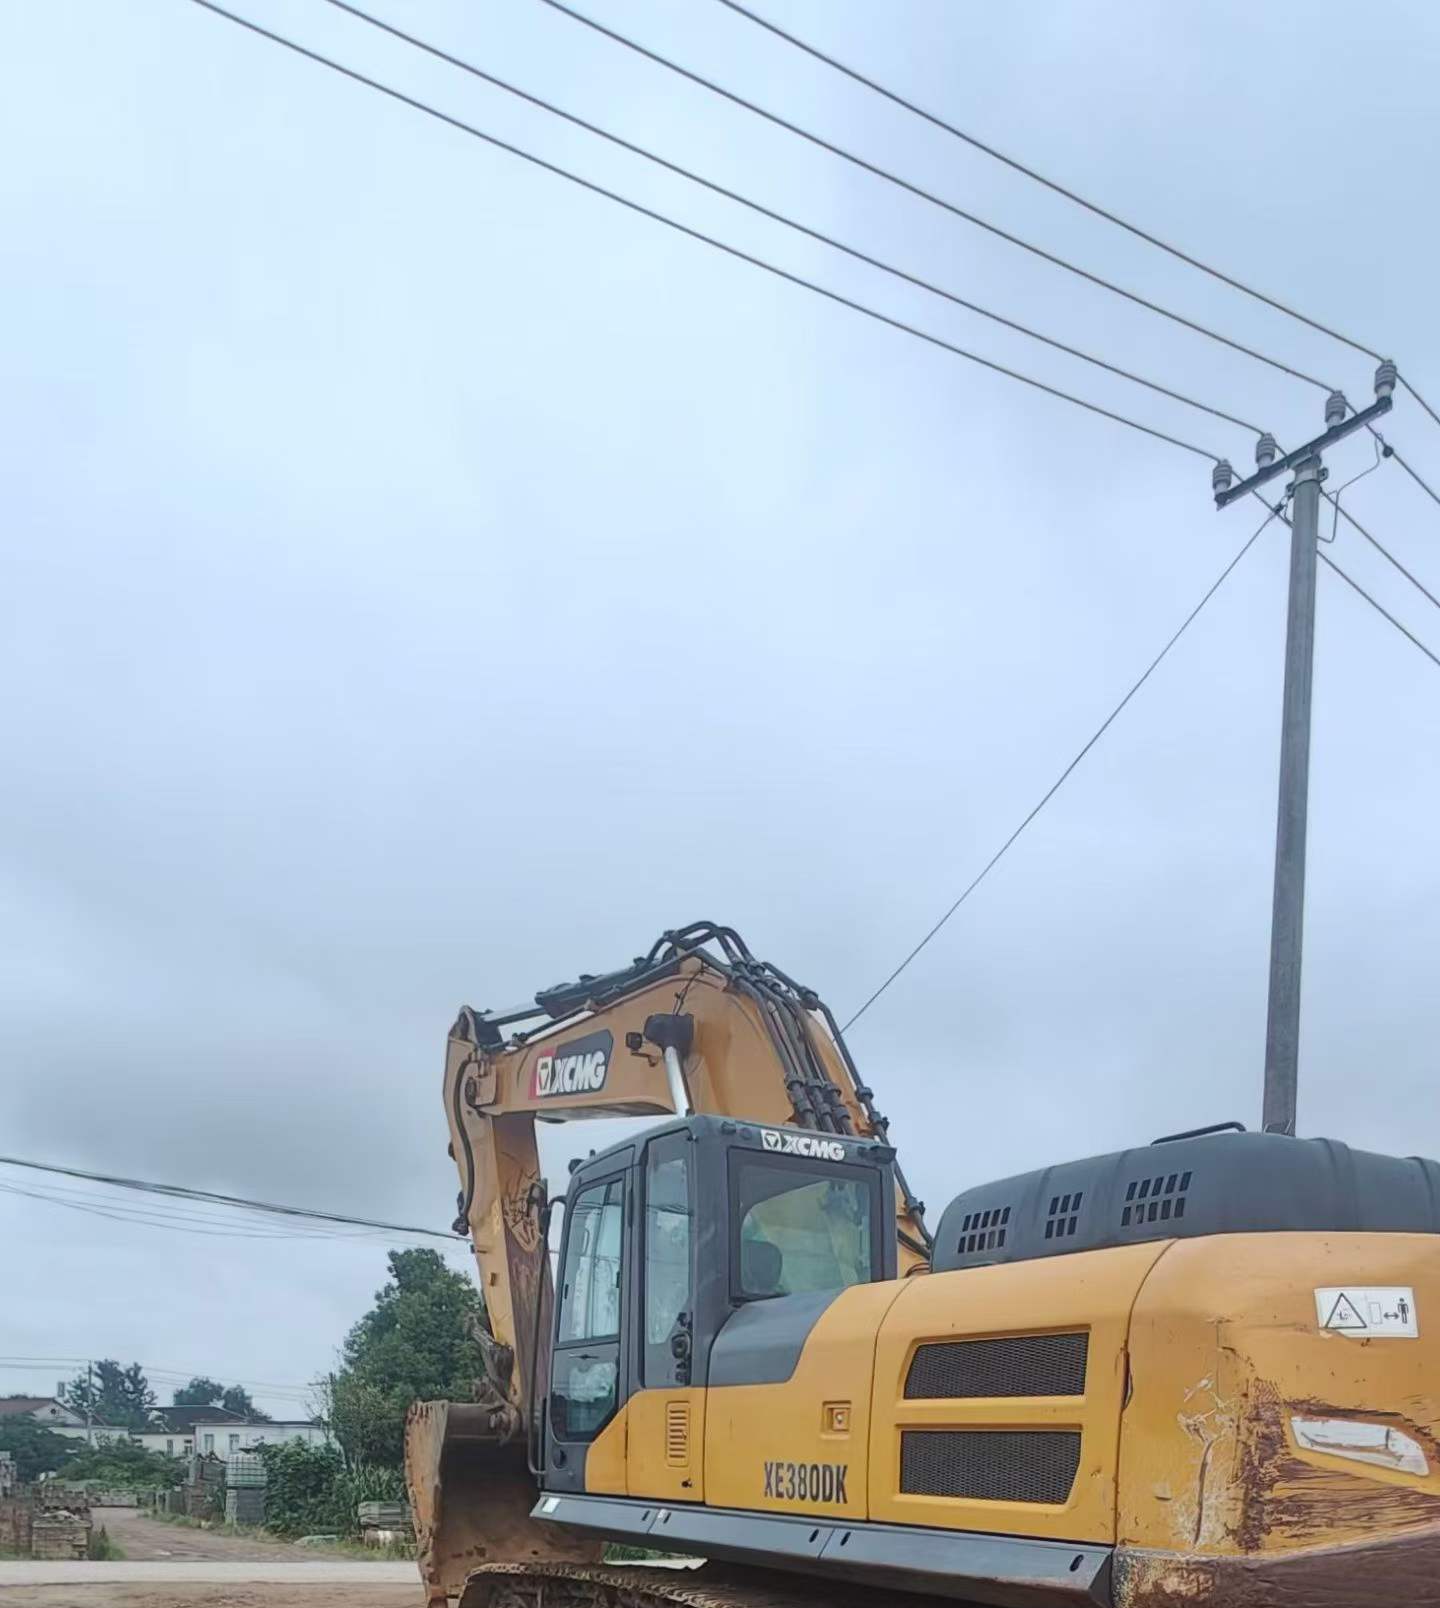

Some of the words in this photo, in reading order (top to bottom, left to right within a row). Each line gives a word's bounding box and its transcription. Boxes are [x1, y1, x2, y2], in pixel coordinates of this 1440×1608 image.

[552, 1050, 605, 1093] XCMG
[782, 1135, 845, 1160] XCMG
[764, 1462, 848, 1504] XE380DK
